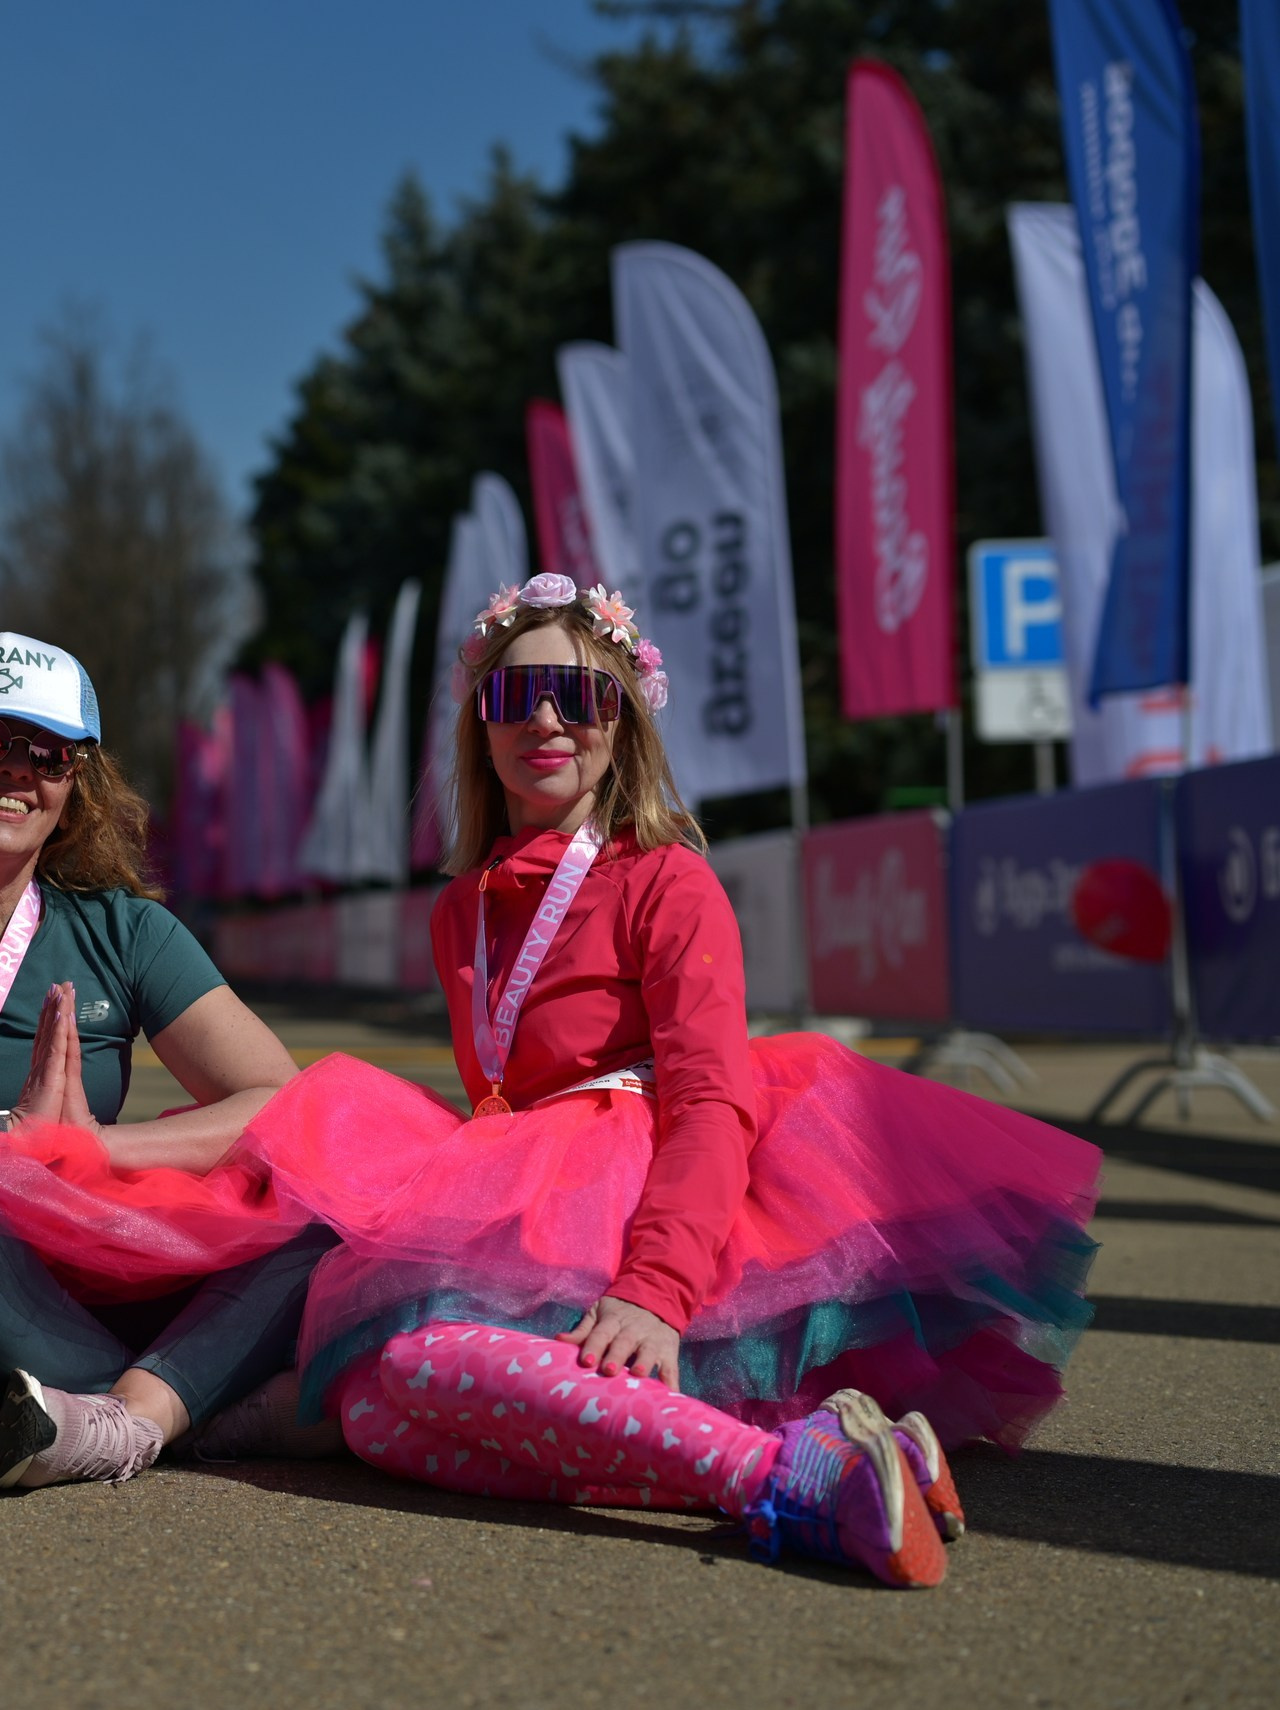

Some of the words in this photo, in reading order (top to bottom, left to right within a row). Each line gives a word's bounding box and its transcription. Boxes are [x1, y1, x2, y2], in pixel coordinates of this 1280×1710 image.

[1002, 557, 1062, 657] P
[494, 928, 549, 1048] BEAUTY
[539, 862, 585, 925] RUN
